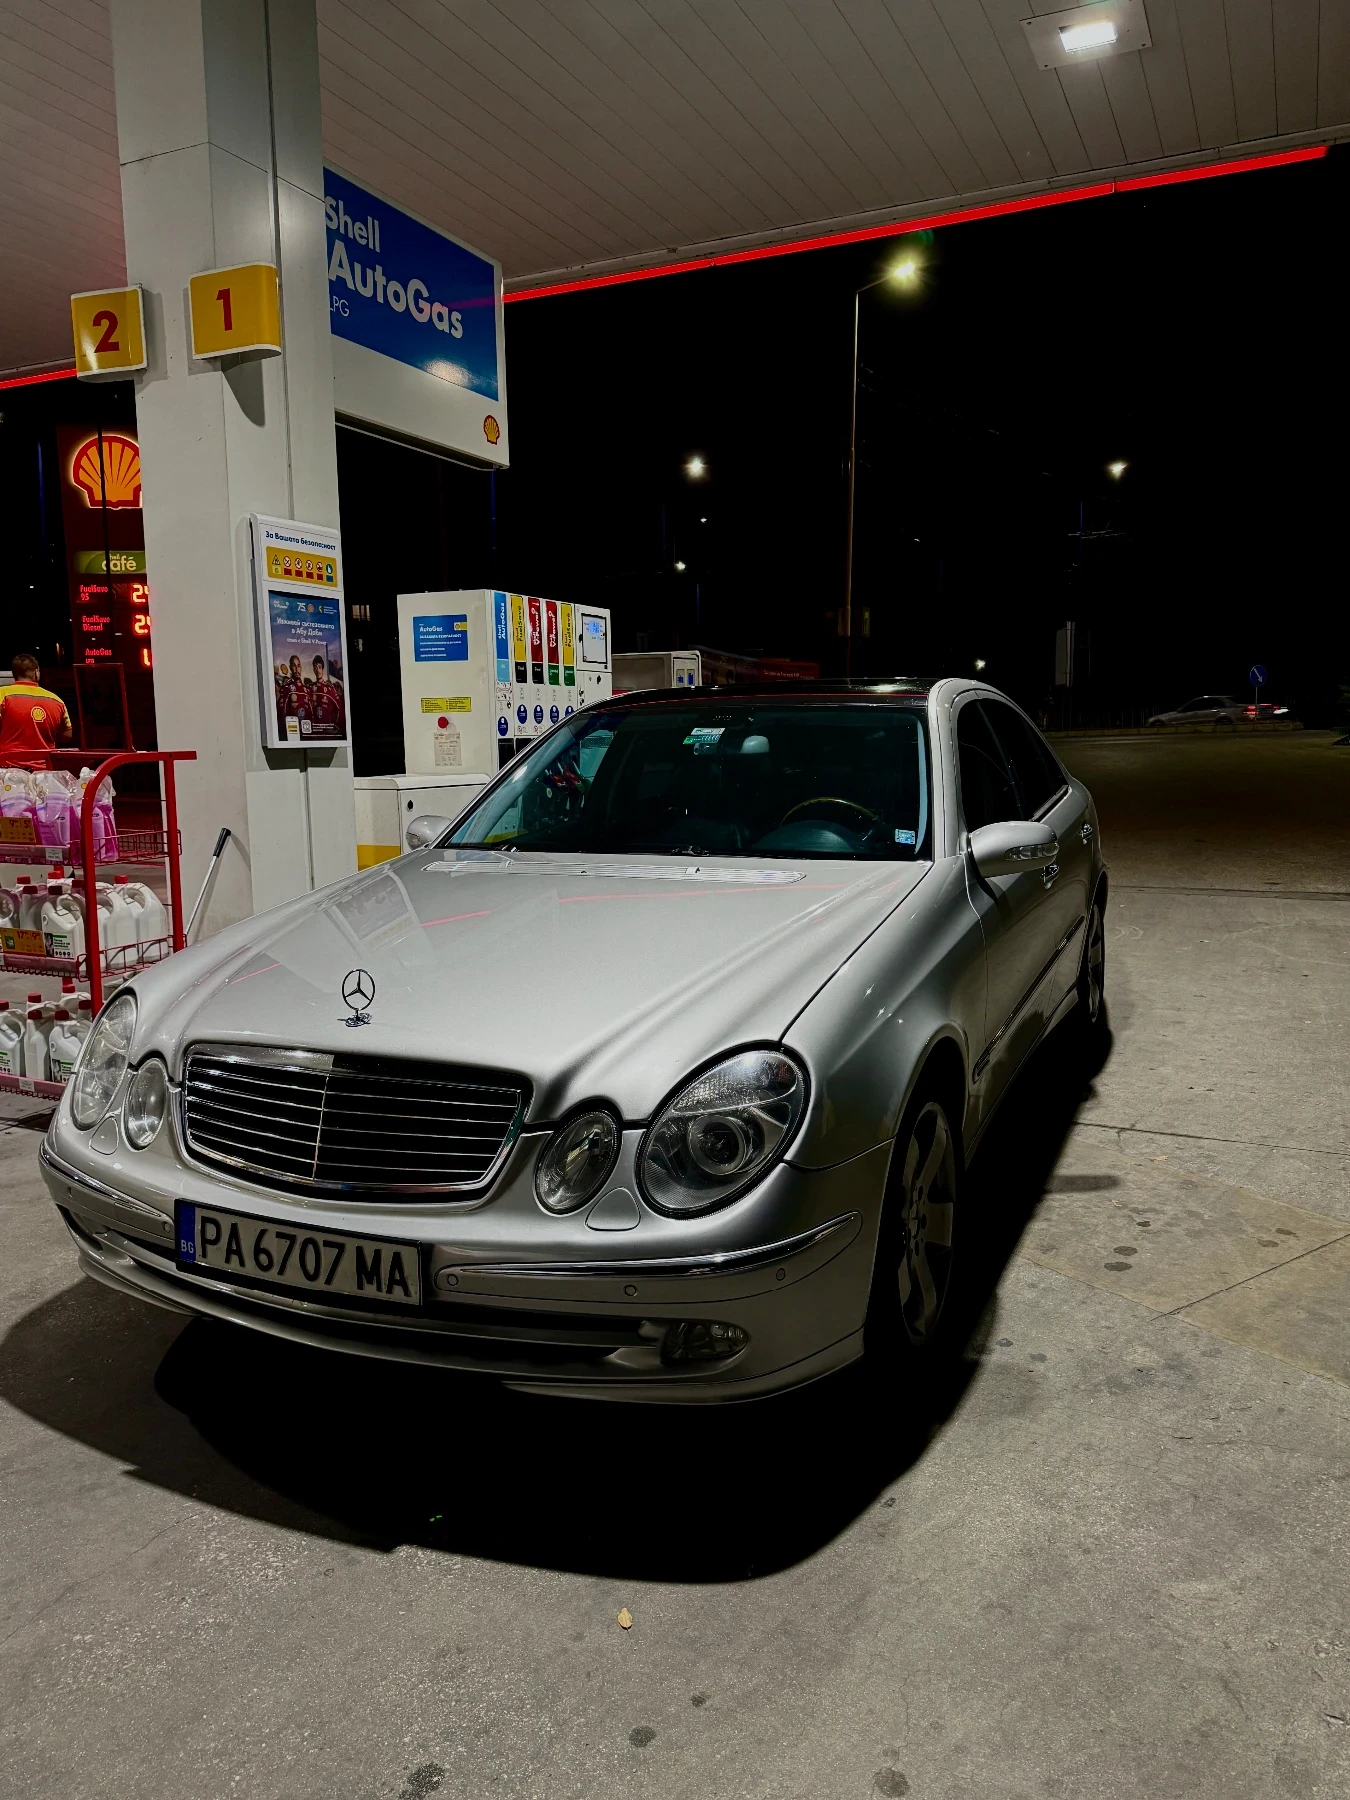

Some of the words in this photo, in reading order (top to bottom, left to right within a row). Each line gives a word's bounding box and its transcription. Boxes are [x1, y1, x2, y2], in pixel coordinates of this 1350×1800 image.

[325, 196, 380, 253] Shell
[216, 288, 233, 331] 1
[328, 239, 463, 339] AutoGas
[92, 310, 120, 353] 2
[101, 556, 137, 571] café
[274, 533, 300, 544] Вашата
[300, 538, 336, 551] безопасност
[181, 1239, 194, 1254] BG
[200, 1215, 246, 1268] PA
[253, 1228, 347, 1286] 6707
[355, 1245, 412, 1298] MA
